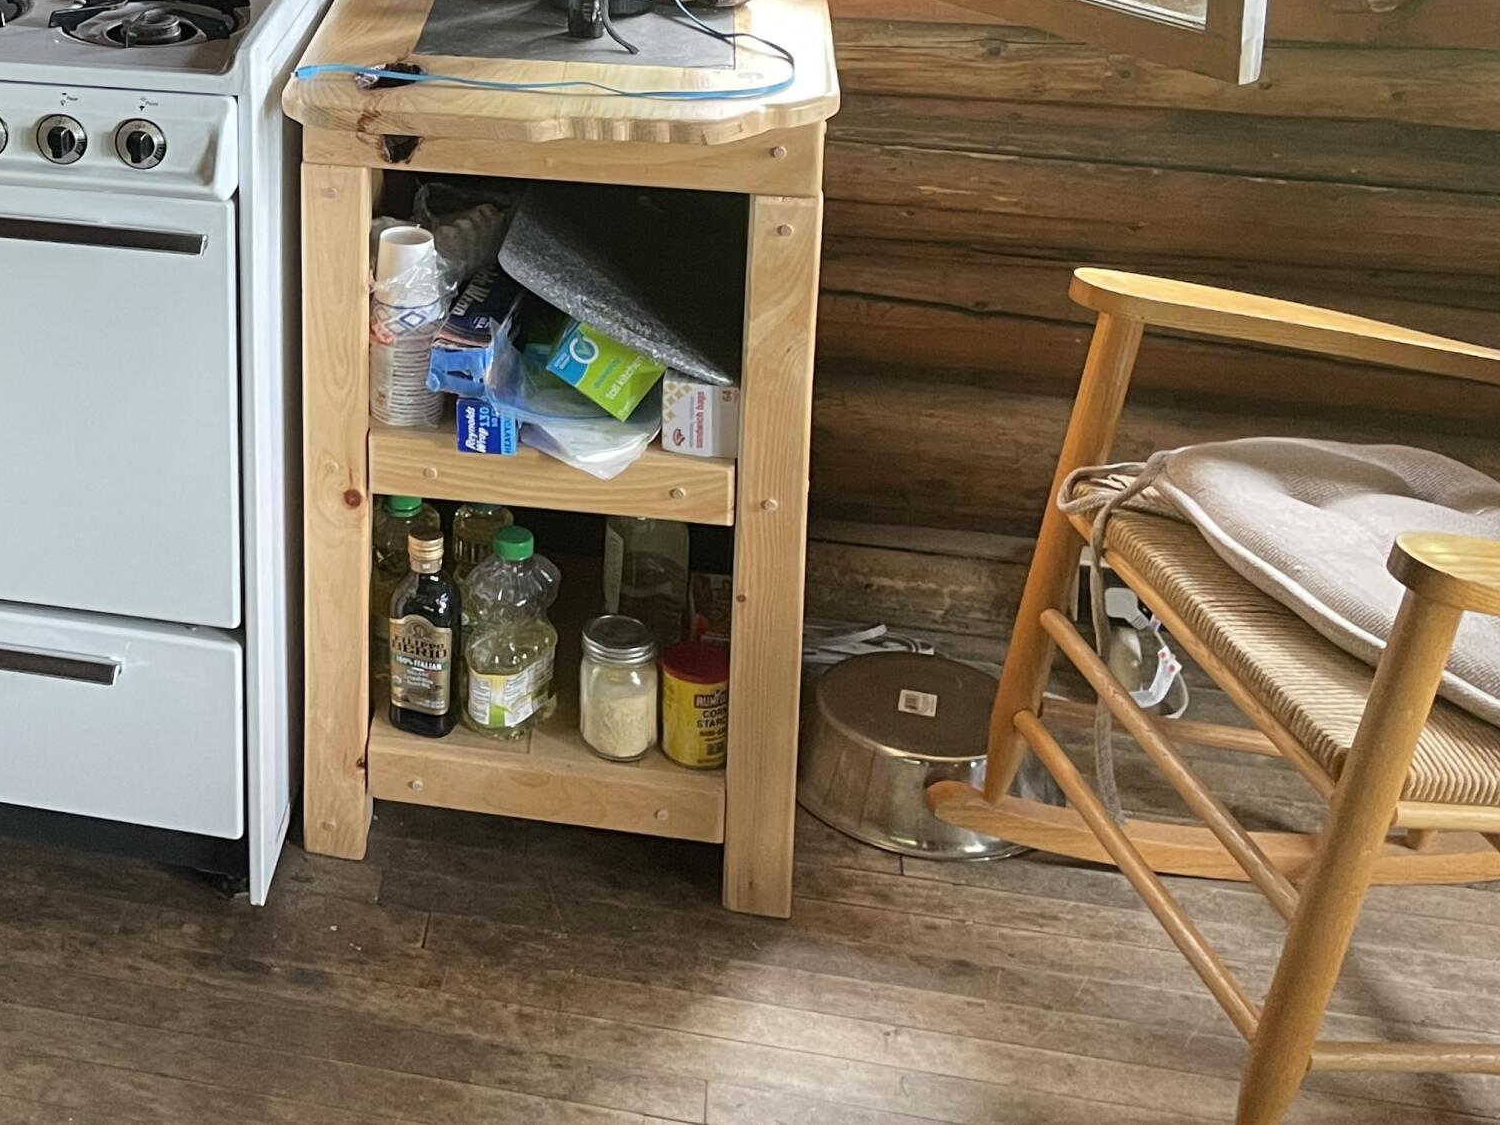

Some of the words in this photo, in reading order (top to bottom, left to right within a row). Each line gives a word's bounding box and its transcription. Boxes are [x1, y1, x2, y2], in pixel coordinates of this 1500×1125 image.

[465, 406, 478, 450] Reynolds
[476, 427, 489, 453] Wrap
[503, 427, 512, 454] HEAVY
[413, 659, 443, 671] ITALIAN
